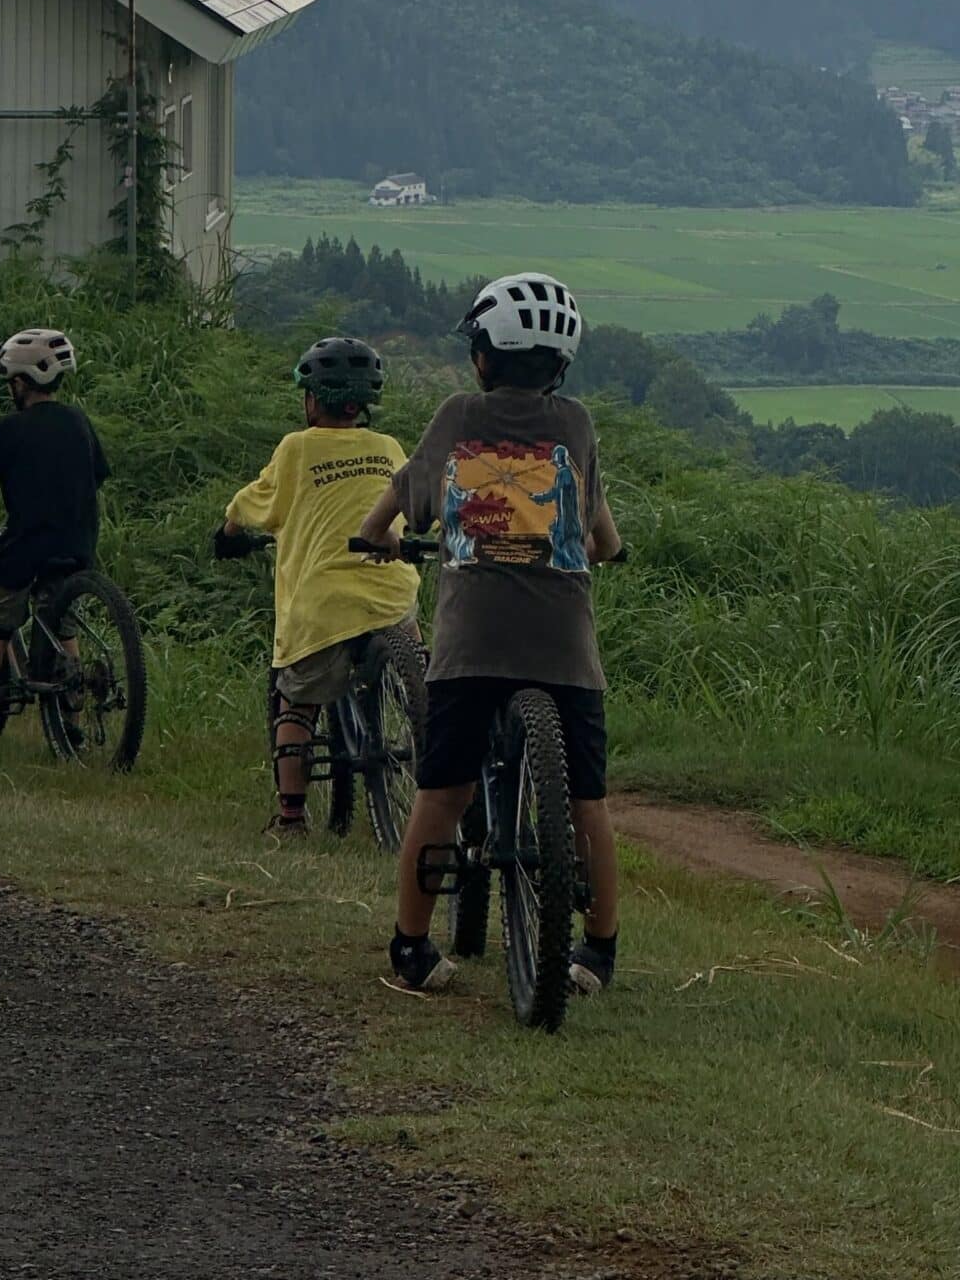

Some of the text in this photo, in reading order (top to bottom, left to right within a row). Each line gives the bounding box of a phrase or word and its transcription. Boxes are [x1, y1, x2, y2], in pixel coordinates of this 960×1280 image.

[309, 461, 336, 475] THE
[335, 457, 363, 468] GOU
[313, 466, 393, 488] PLEASUREROO
